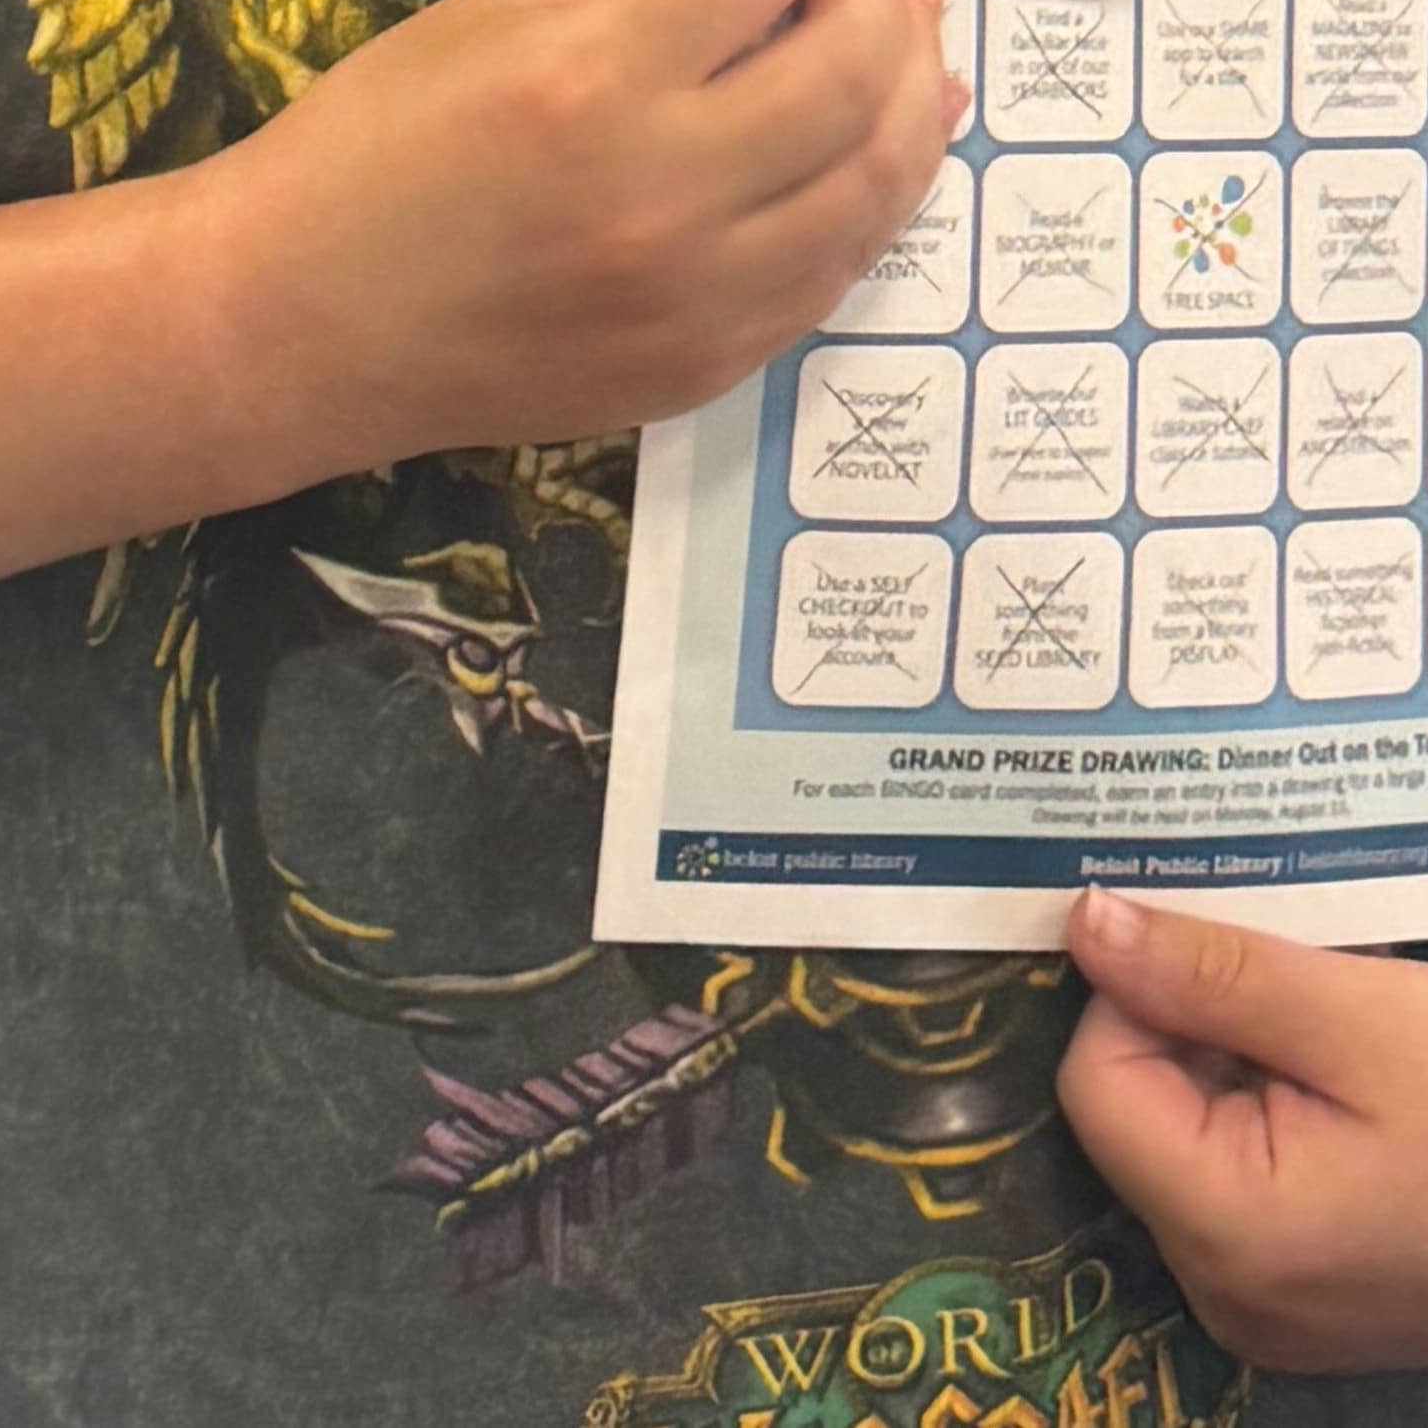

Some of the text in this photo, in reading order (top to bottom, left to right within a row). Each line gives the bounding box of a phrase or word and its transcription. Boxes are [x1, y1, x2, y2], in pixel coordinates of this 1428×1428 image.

[798, 597, 905, 617] CHECKOUT
[889, 748, 985, 772] GRAND
[993, 749, 1072, 774] PRIZE
[1080, 748, 1210, 774] DRAWING:
[1217, 744, 1292, 771] Dinner
[1298, 741, 1339, 766] Out
[1342, 742, 1370, 762] on
[1374, 737, 1410, 760] the
[791, 779, 825, 798] For
[880, 780, 945, 800] BINGO
[948, 782, 991, 801] card
[783, 850, 847, 874] public
[850, 851, 919, 876] library
[1080, 853, 1284, 878] Beloit Public Library
[737, 1257, 1113, 1398] WORLD
